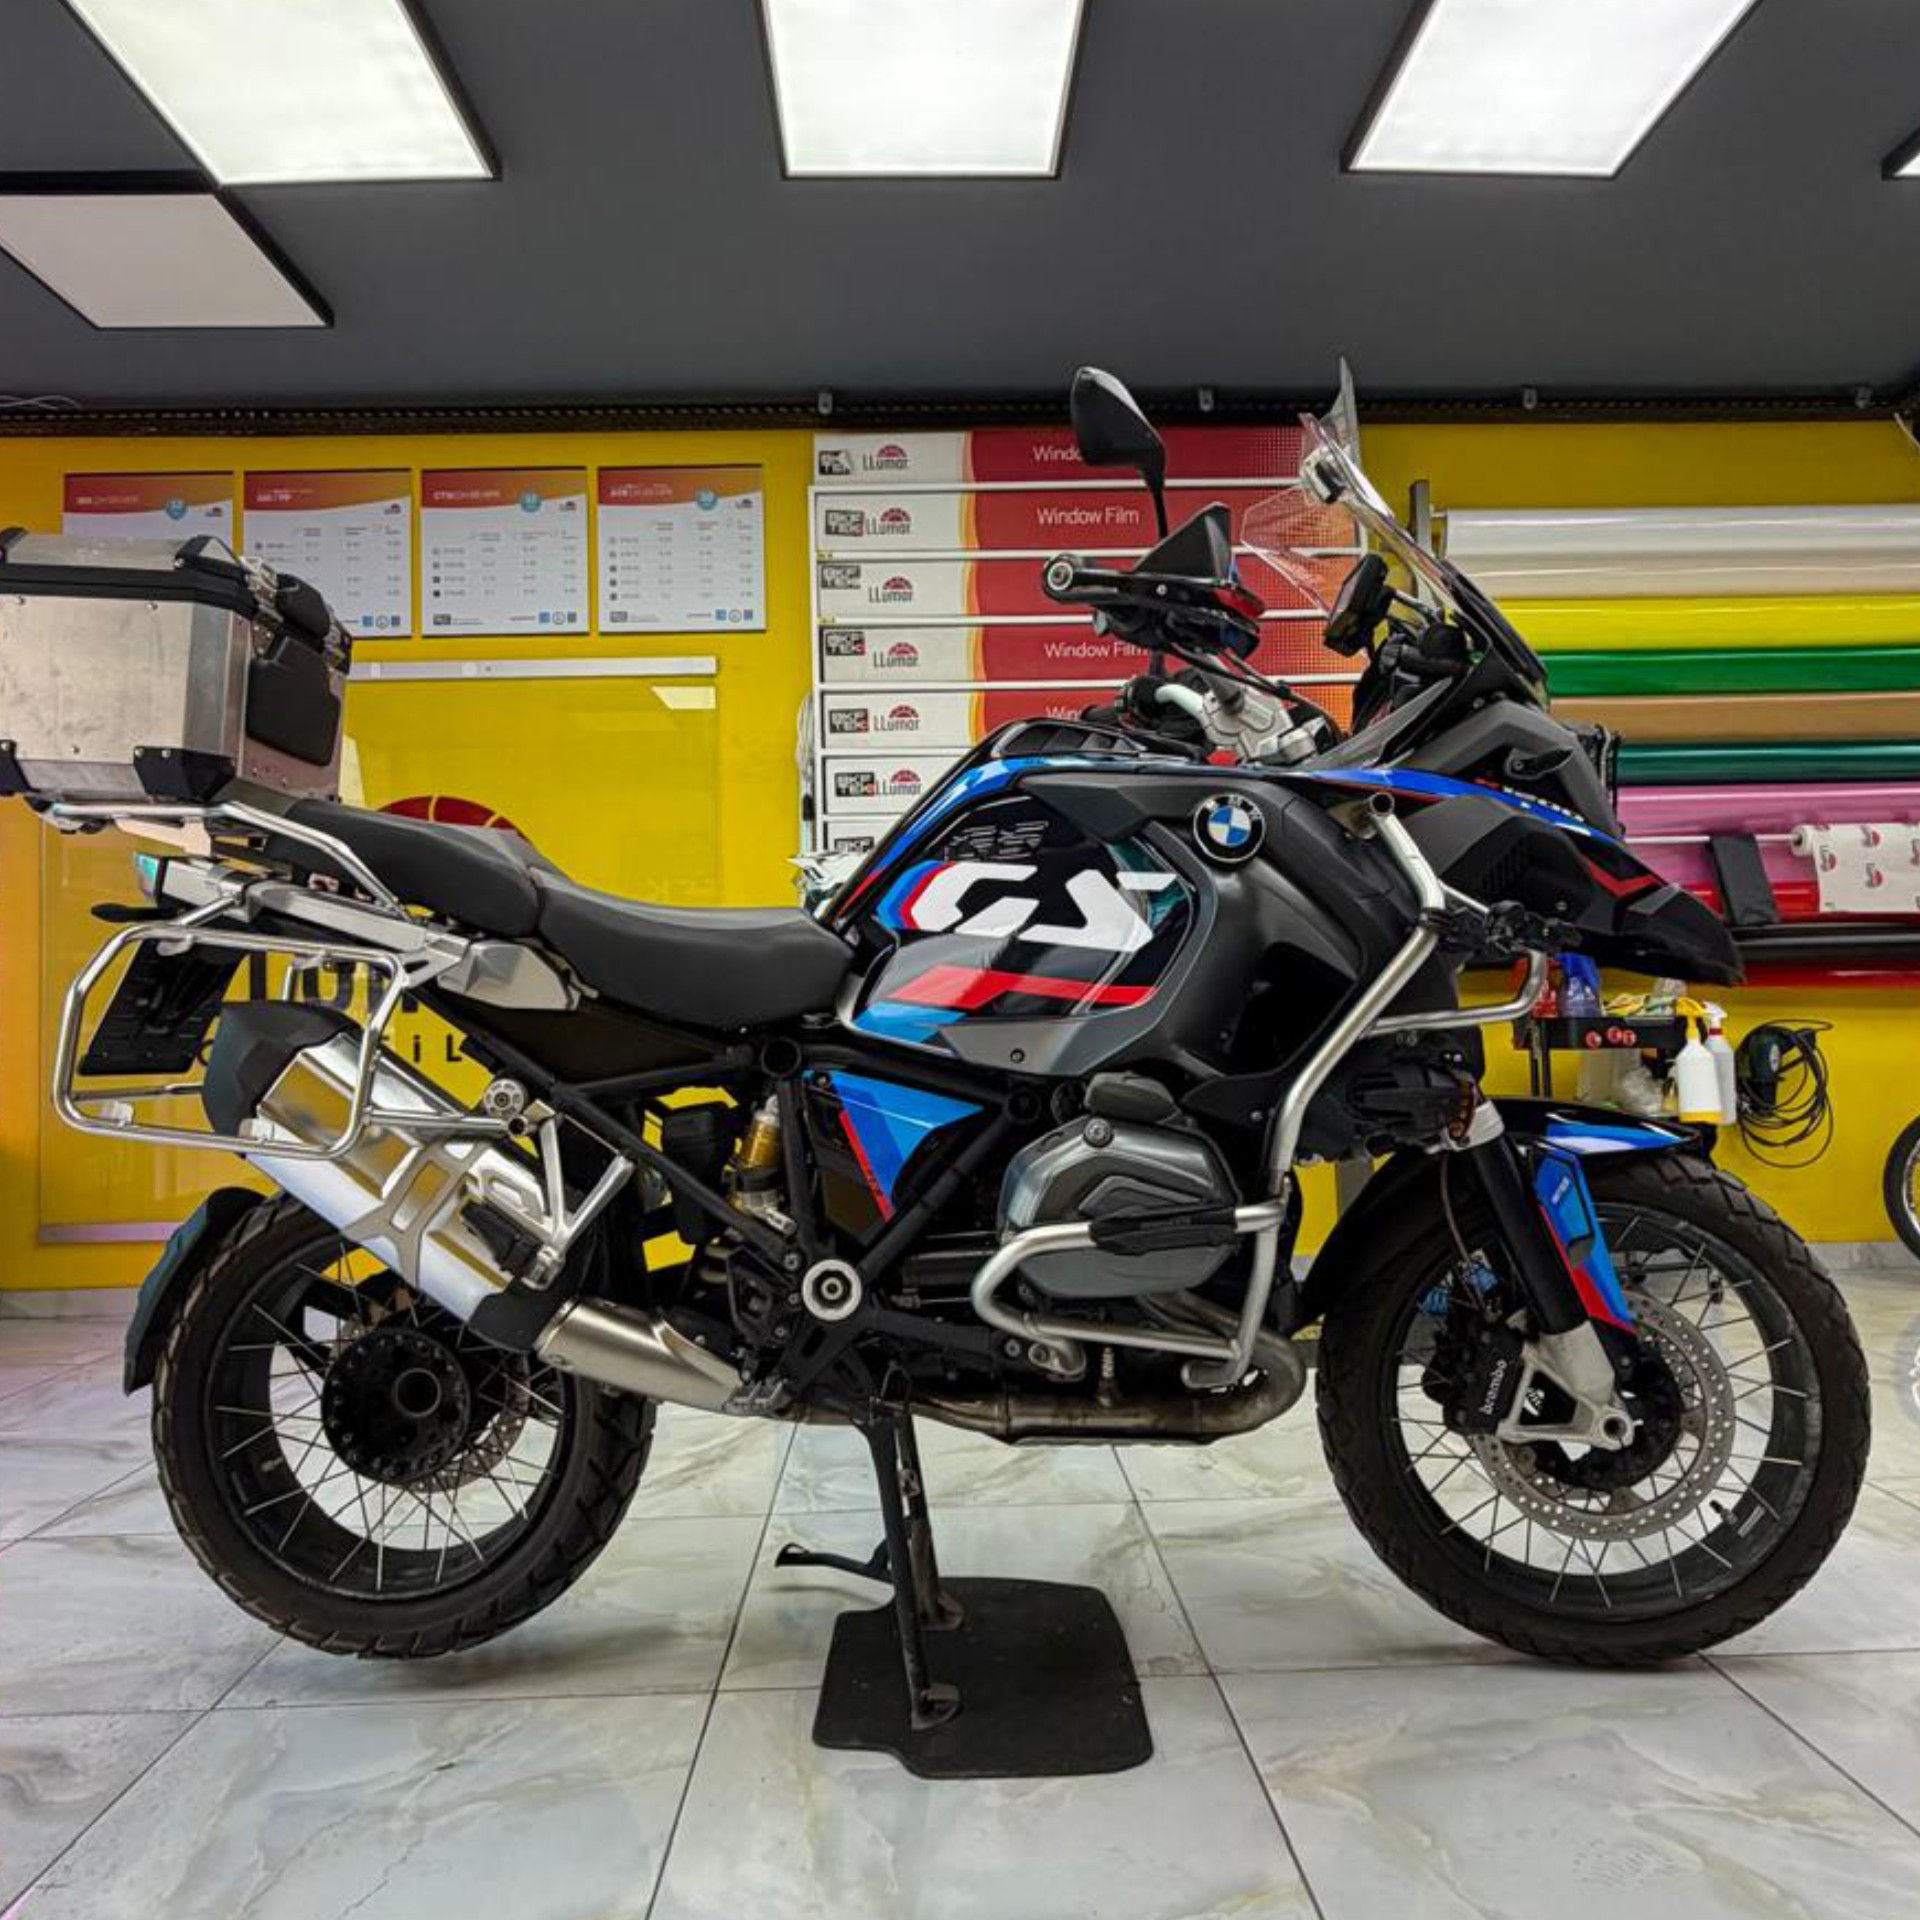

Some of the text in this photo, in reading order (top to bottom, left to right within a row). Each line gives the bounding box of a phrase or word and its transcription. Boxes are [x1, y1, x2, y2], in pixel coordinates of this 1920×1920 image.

[1033, 446, 1082, 461] Wind
[1037, 506, 1140, 525] Window Film
[1044, 641, 1149, 658] Window Film
[873, 714, 920, 731] LLumar
[876, 779, 921, 796] LLumar
[1478, 1359, 1508, 1416] brembo
